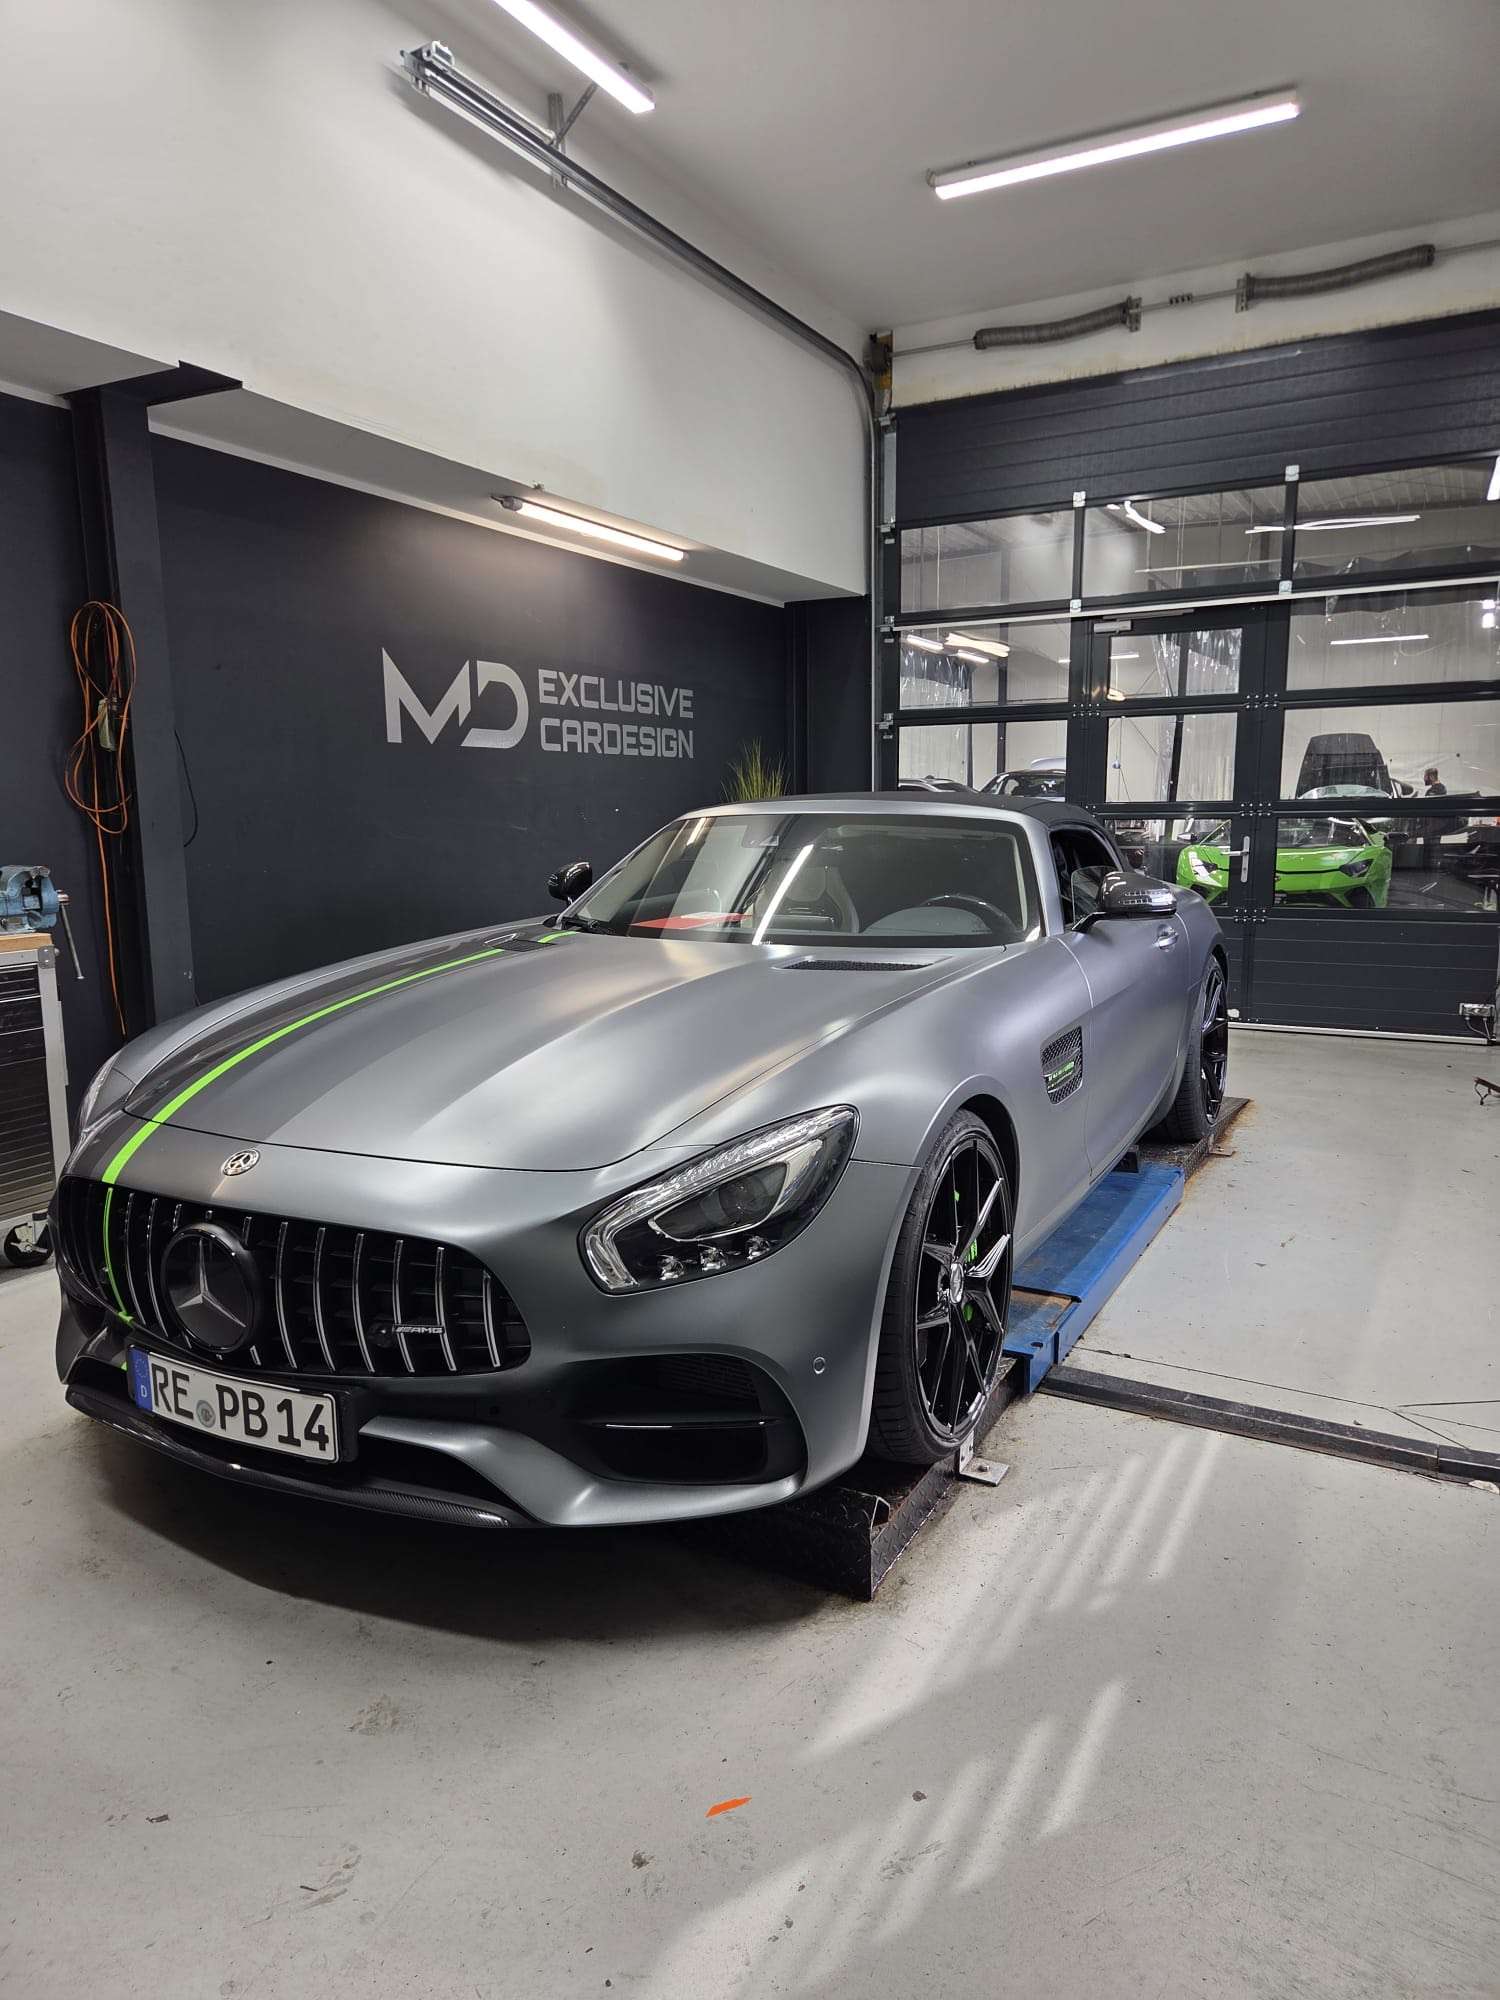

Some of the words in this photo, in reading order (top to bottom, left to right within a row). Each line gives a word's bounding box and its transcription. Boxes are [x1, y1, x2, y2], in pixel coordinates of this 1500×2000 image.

[382, 647, 529, 749] MD
[538, 668, 694, 719] EXCLUSIVE
[540, 716, 695, 759] CARDESIGN
[151, 1363, 194, 1420] RE
